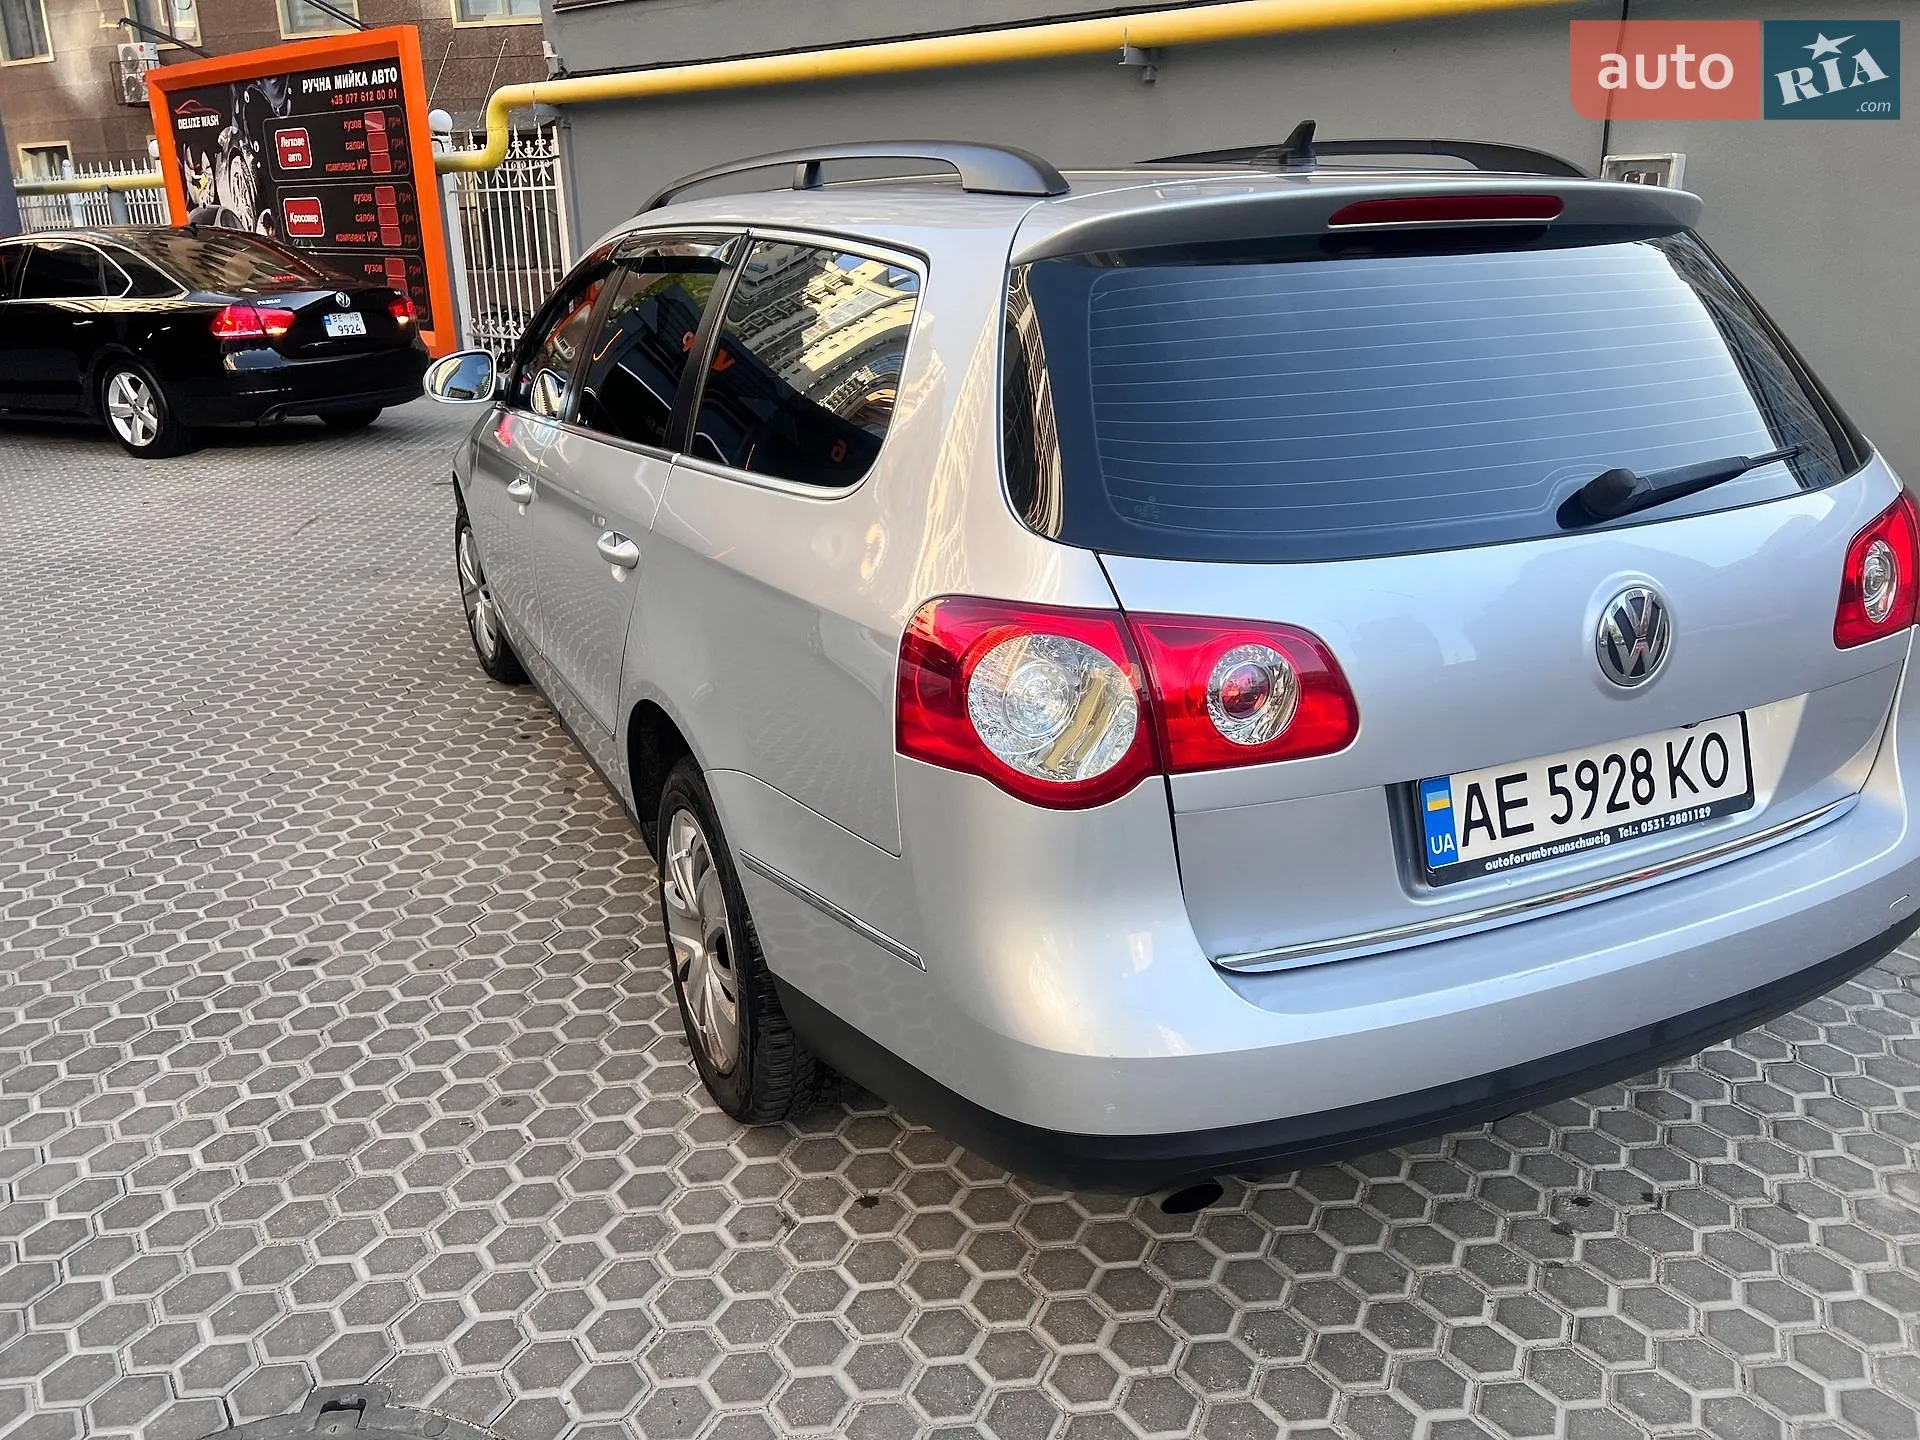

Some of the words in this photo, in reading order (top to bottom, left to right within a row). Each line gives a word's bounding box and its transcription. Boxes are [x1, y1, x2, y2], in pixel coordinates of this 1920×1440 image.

[302, 77, 331, 93] РУЧНА
[334, 70, 368, 90] МИЙКА
[371, 67, 398, 85] АВТО
[345, 92, 358, 103] 077
[360, 91, 374, 102] 612
[376, 89, 386, 100] 00
[388, 88, 397, 99] 01
[178, 116, 201, 130] DELUXE
[201, 115, 219, 128] WASH
[343, 120, 362, 132] кузов
[280, 136, 305, 149] Легкове
[345, 141, 365, 151] салон
[287, 152, 303, 163] авто
[356, 159, 368, 171] VIP
[353, 193, 372, 205] кузов
[289, 212, 319, 225] Кросовер
[355, 213, 375, 223] салон
[366, 231, 378, 242] VIP
[364, 263, 383, 275] кузов
[337, 324, 362, 335] 9924
[1461, 772, 1534, 847] AE
[1547, 748, 1655, 825] 5928
[1665, 731, 1729, 799] KO
[1431, 833, 1455, 854] UA
[1485, 831, 1611, 871] autoforumbraunschweig
[1618, 826, 1639, 839] Tel.:
[1641, 806, 1711, 833] 0531-2801129
